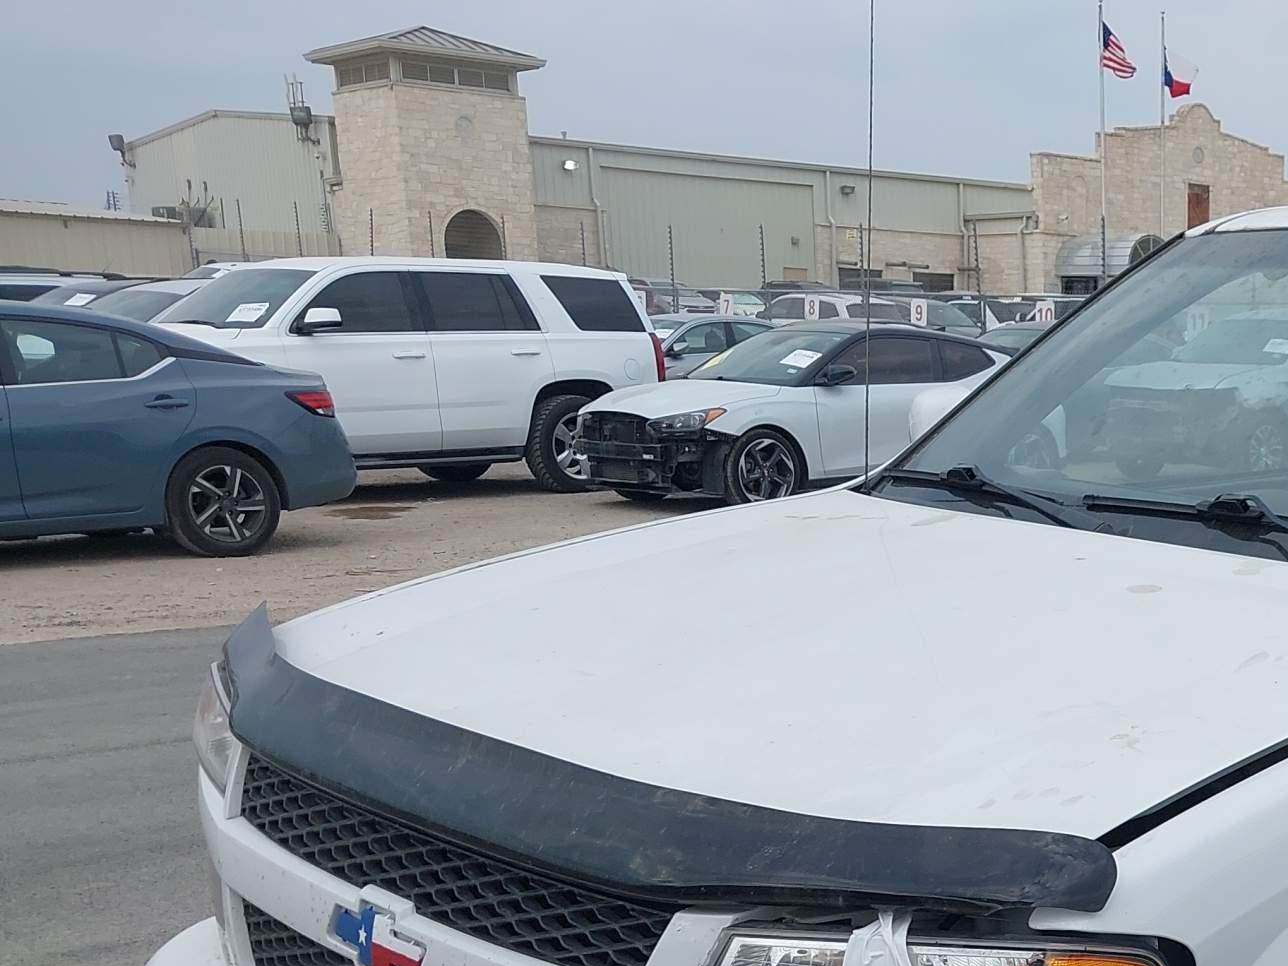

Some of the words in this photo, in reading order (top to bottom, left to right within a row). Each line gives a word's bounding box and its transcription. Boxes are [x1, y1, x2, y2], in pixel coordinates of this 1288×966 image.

[723, 299, 731, 313] 7
[808, 299, 816, 315] 8
[914, 304, 923, 321] 9
[1036, 307, 1053, 321] 10
